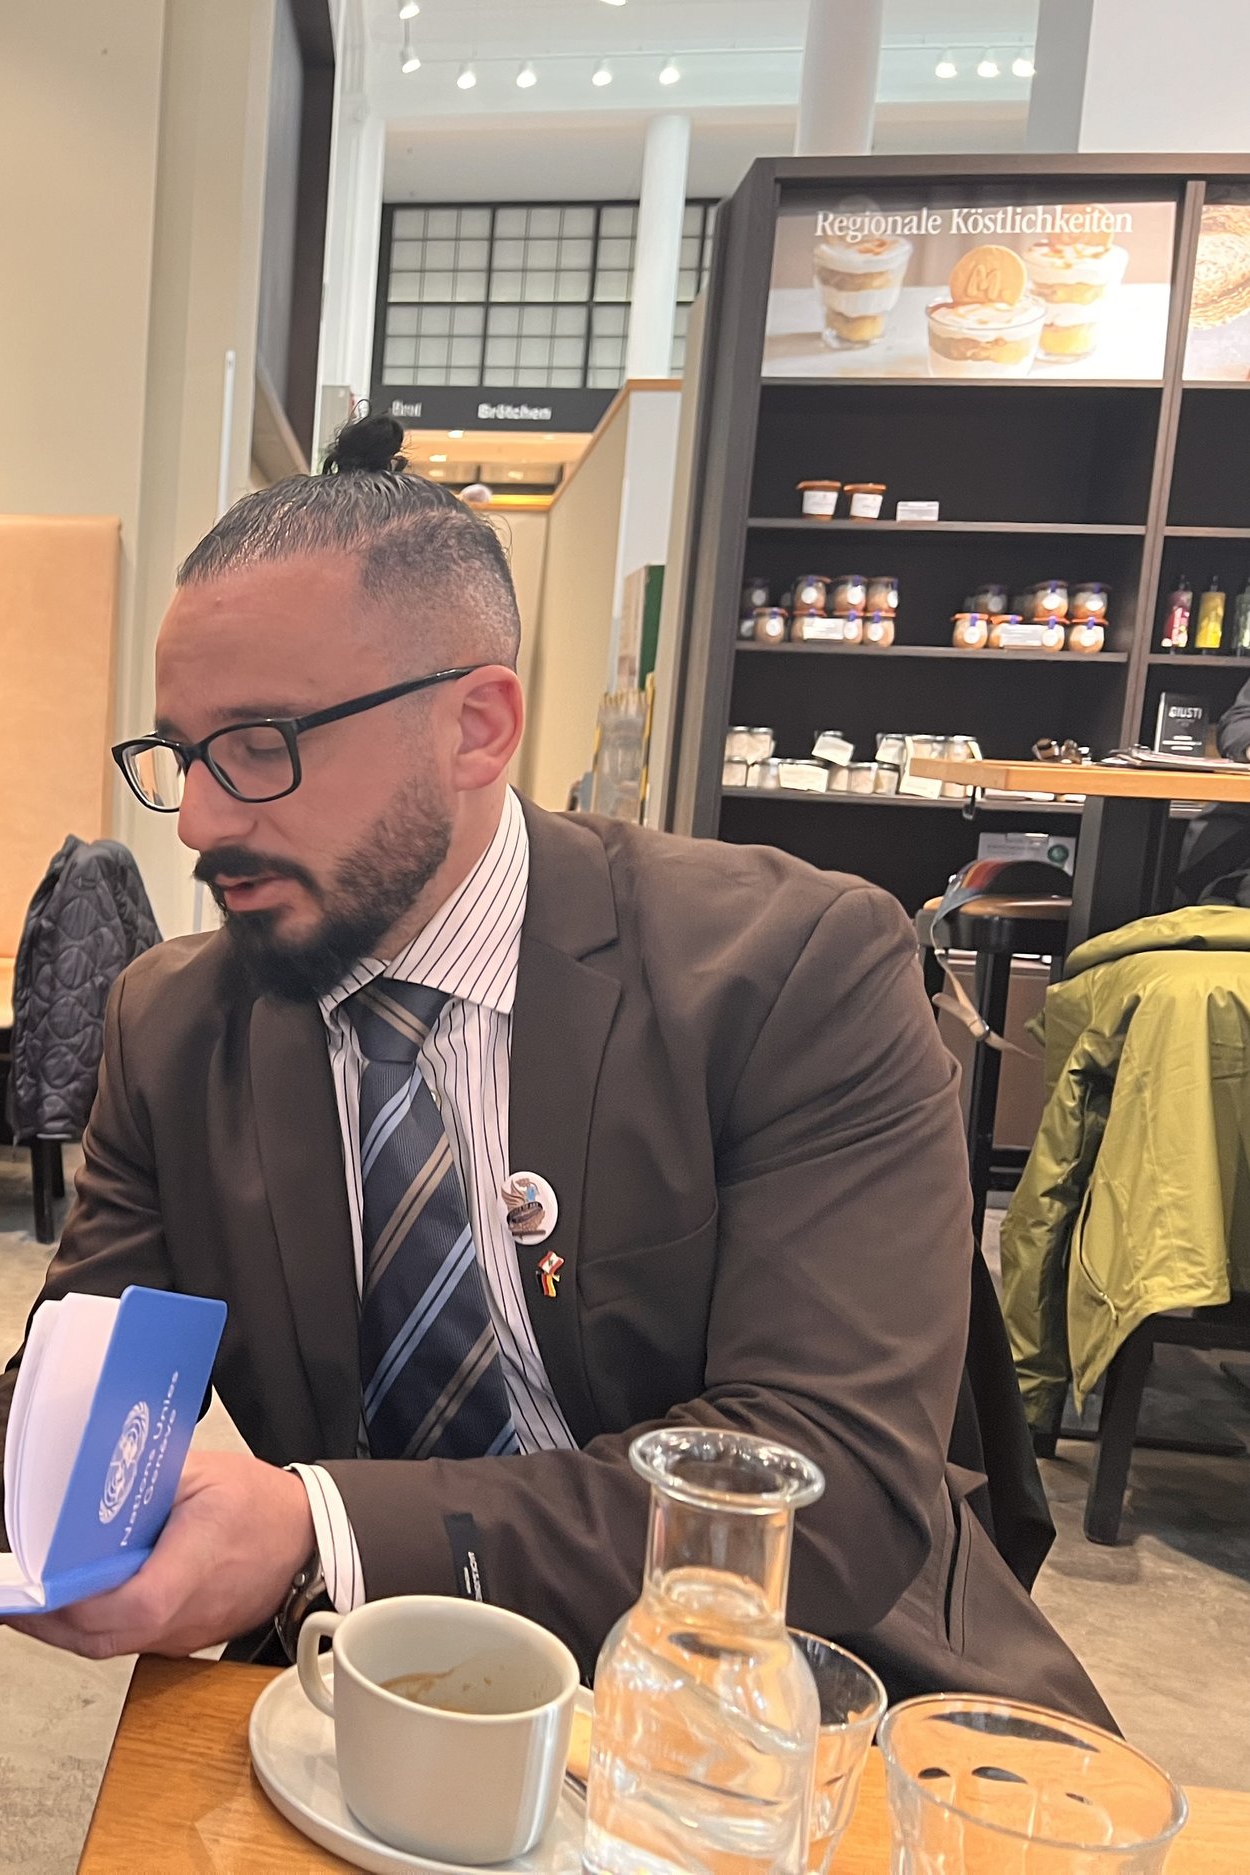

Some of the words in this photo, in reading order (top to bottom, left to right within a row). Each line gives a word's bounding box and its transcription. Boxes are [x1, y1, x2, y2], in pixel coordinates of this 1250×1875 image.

[815, 208, 941, 243] Regionale
[949, 204, 1133, 234] Köstlichkeiten
[120, 1448, 155, 1546] Nations
[153, 1371, 178, 1439] Unies
